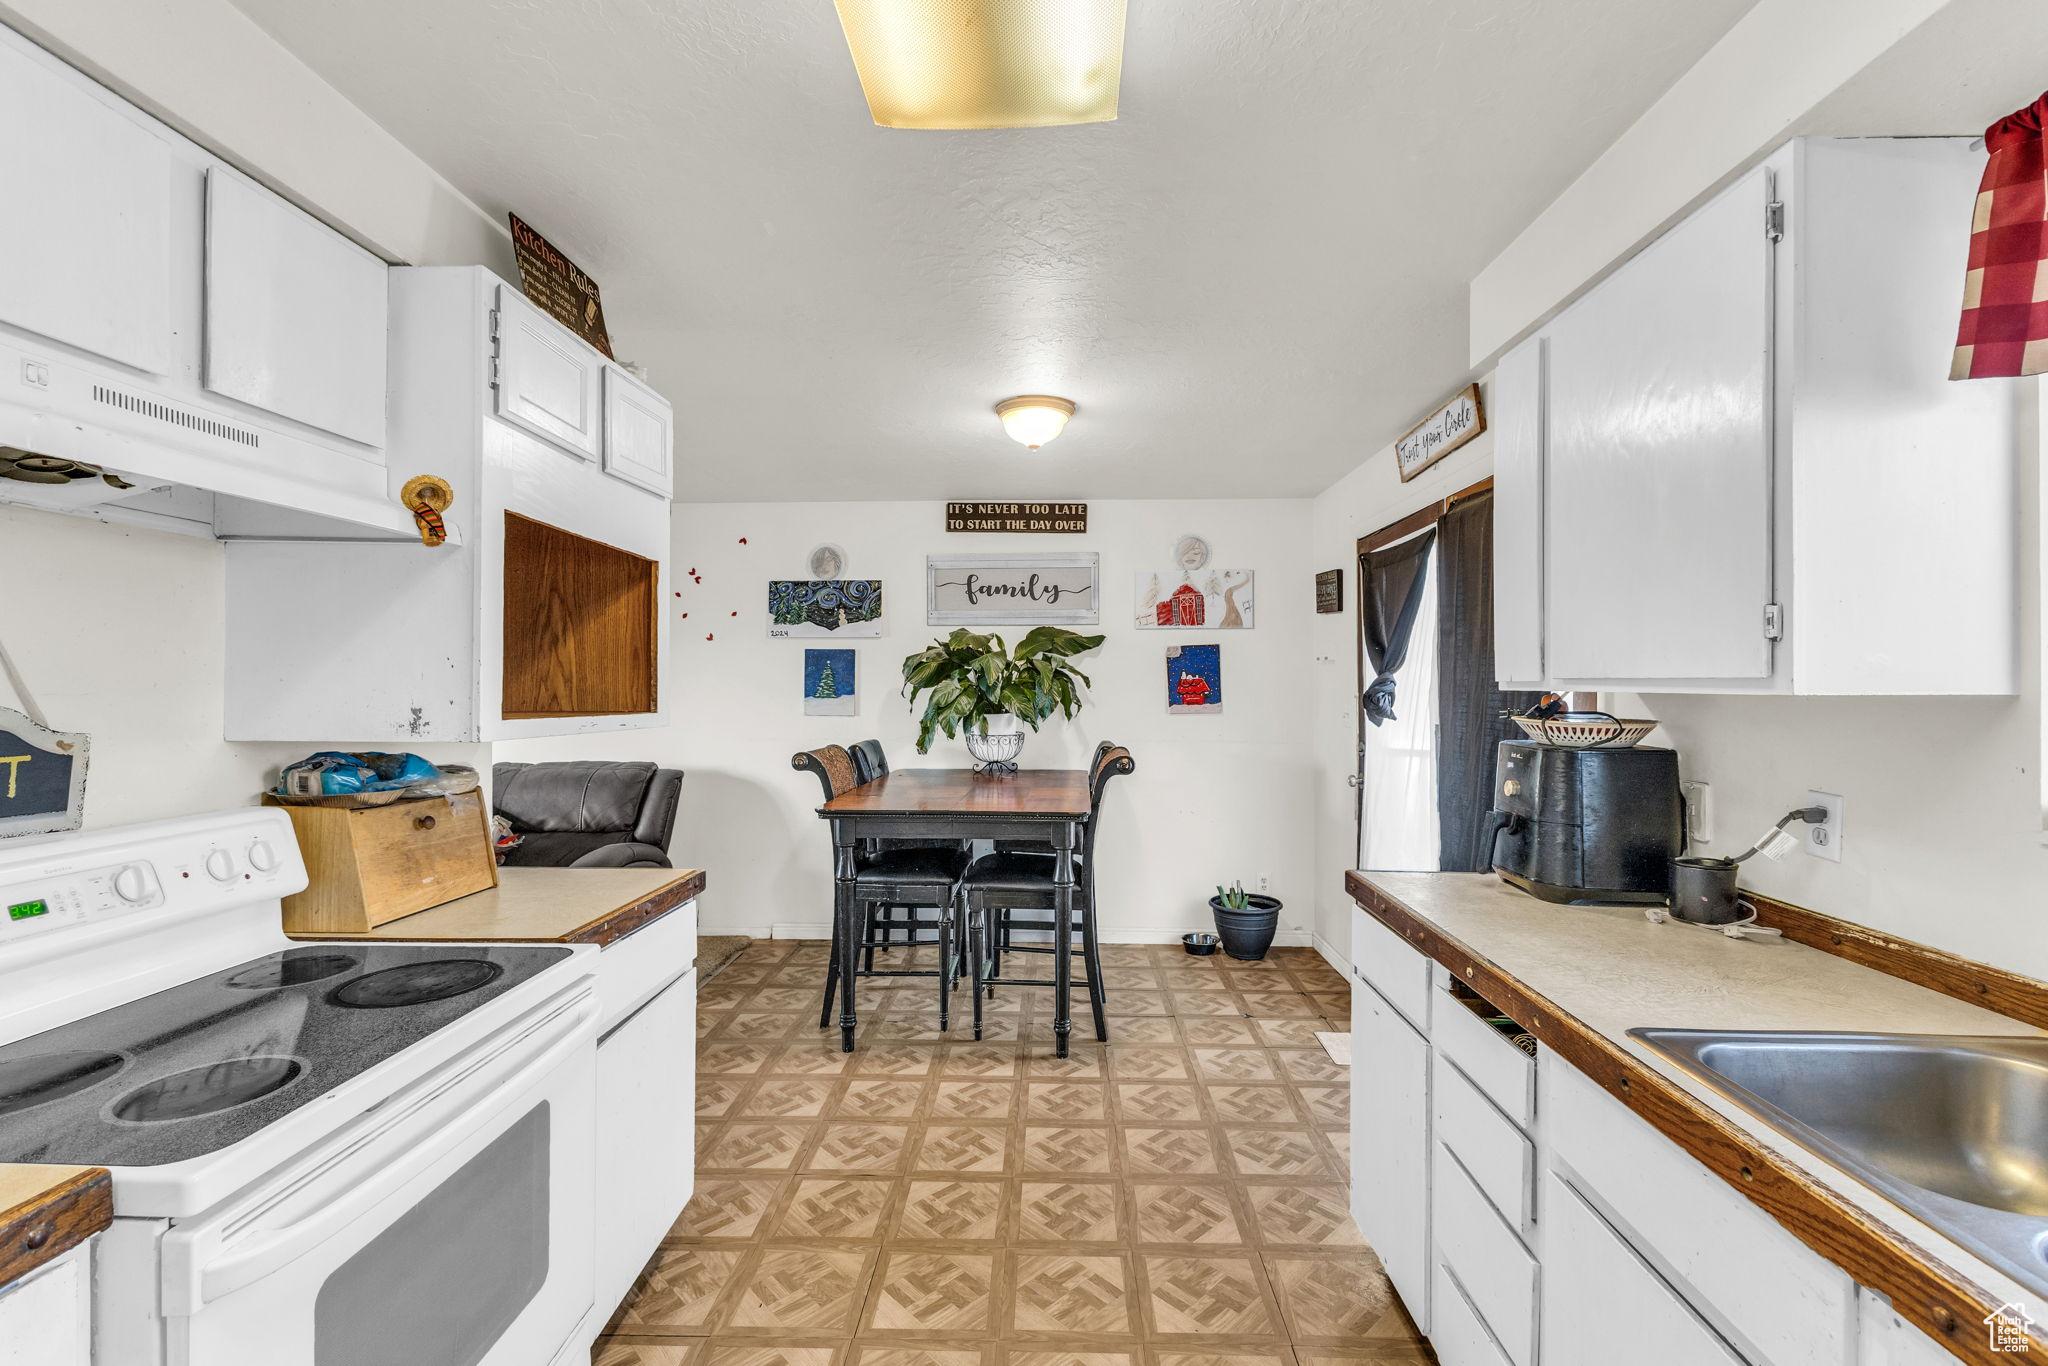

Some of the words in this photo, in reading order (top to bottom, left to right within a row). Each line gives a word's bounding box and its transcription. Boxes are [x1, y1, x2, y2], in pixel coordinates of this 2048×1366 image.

[512, 217, 566, 276] Kitchen
[568, 262, 600, 302] Rules
[1401, 434, 1419, 467] Trust
[1422, 430, 1442, 459] your
[1445, 398, 1471, 437] Circle
[949, 504, 973, 514] IT'S
[979, 504, 1018, 514] NEVER
[1024, 504, 1049, 515] TOO
[1055, 504, 1085, 515] LATE
[949, 519, 964, 530] TO
[967, 519, 1001, 530] START
[1005, 520, 1027, 530] THE
[1030, 520, 1052, 530] DAY
[1055, 520, 1085, 531] OVER
[965, 573, 1060, 605] family
